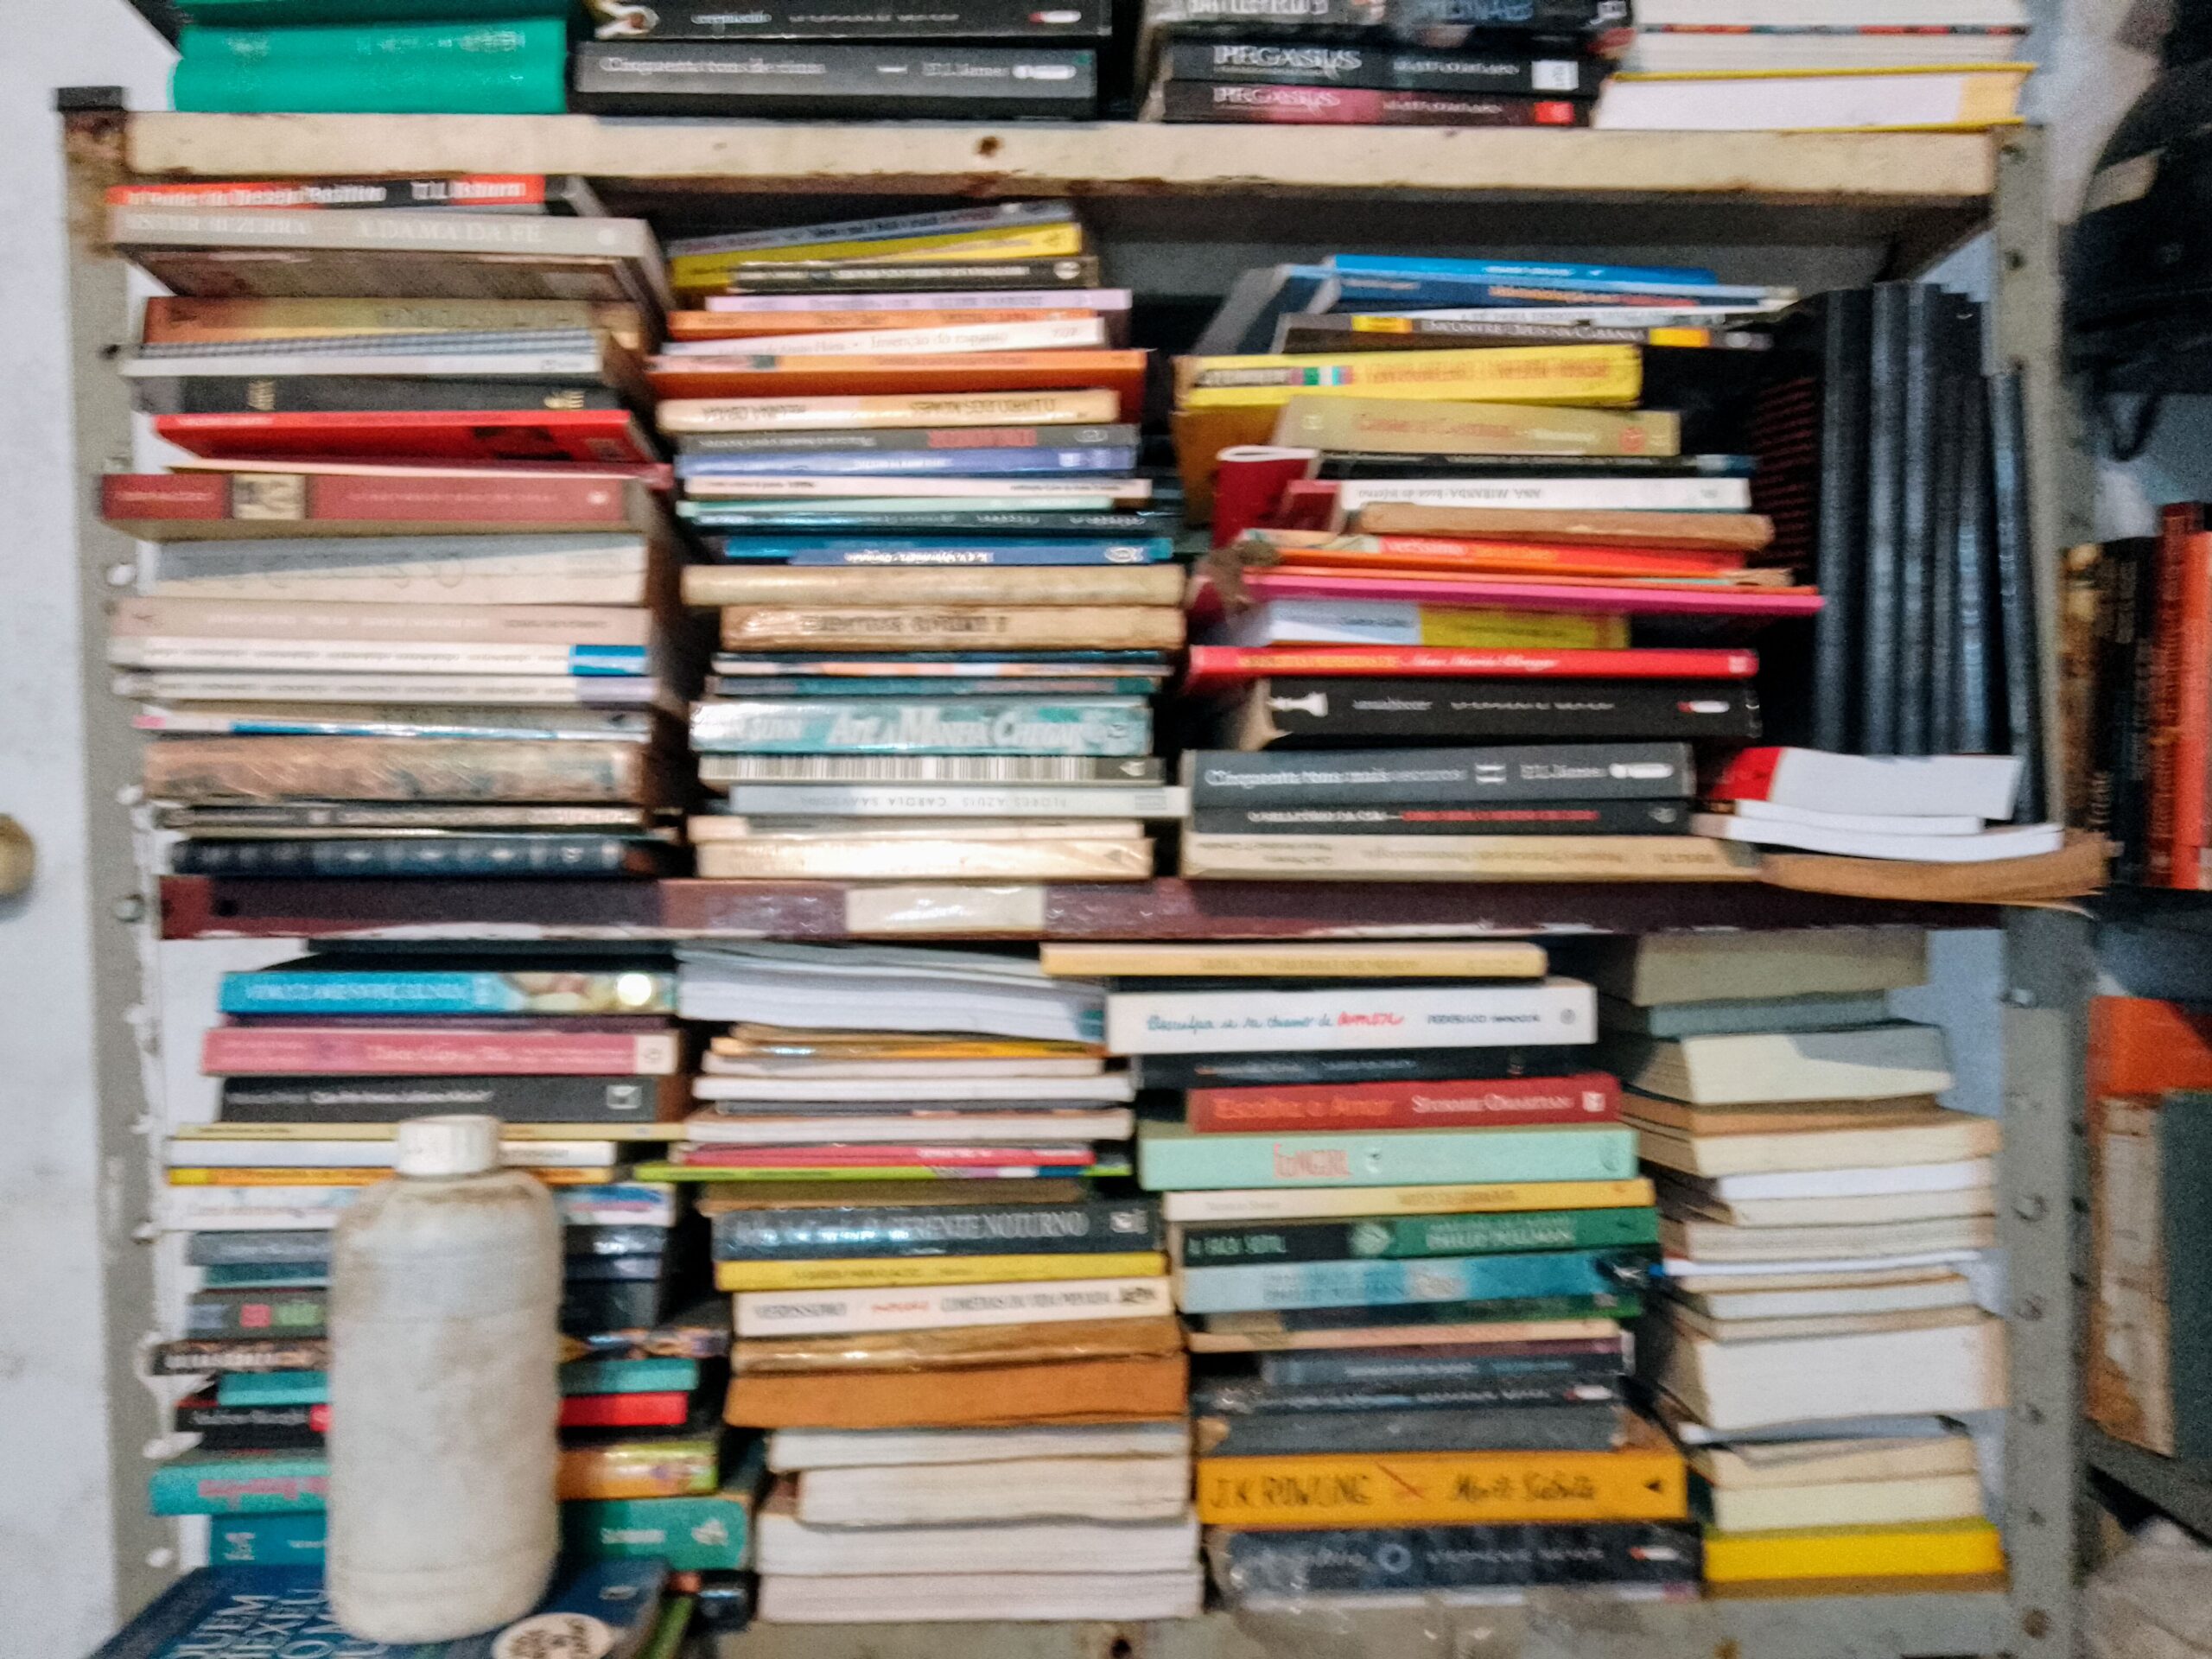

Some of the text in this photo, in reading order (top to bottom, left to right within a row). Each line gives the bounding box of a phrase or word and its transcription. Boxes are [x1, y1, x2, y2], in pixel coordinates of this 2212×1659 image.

[1211, 48, 1363, 76] PEGASUS
[1211, 87, 1342, 112] PEGASUS
[1205, 766, 1469, 789] Cinquenta tons mais escuros
[887, 795, 948, 808] CAROLA
[961, 796, 1006, 808] AZUIS
[1211, 1096, 1307, 1119] Escolha
[1330, 1095, 1396, 1117] Amor
[984, 1211, 1093, 1240] NOTURNO
[754, 1302, 848, 1320] VERISSIMO
[1261, 1473, 1372, 1506] ROWLING
